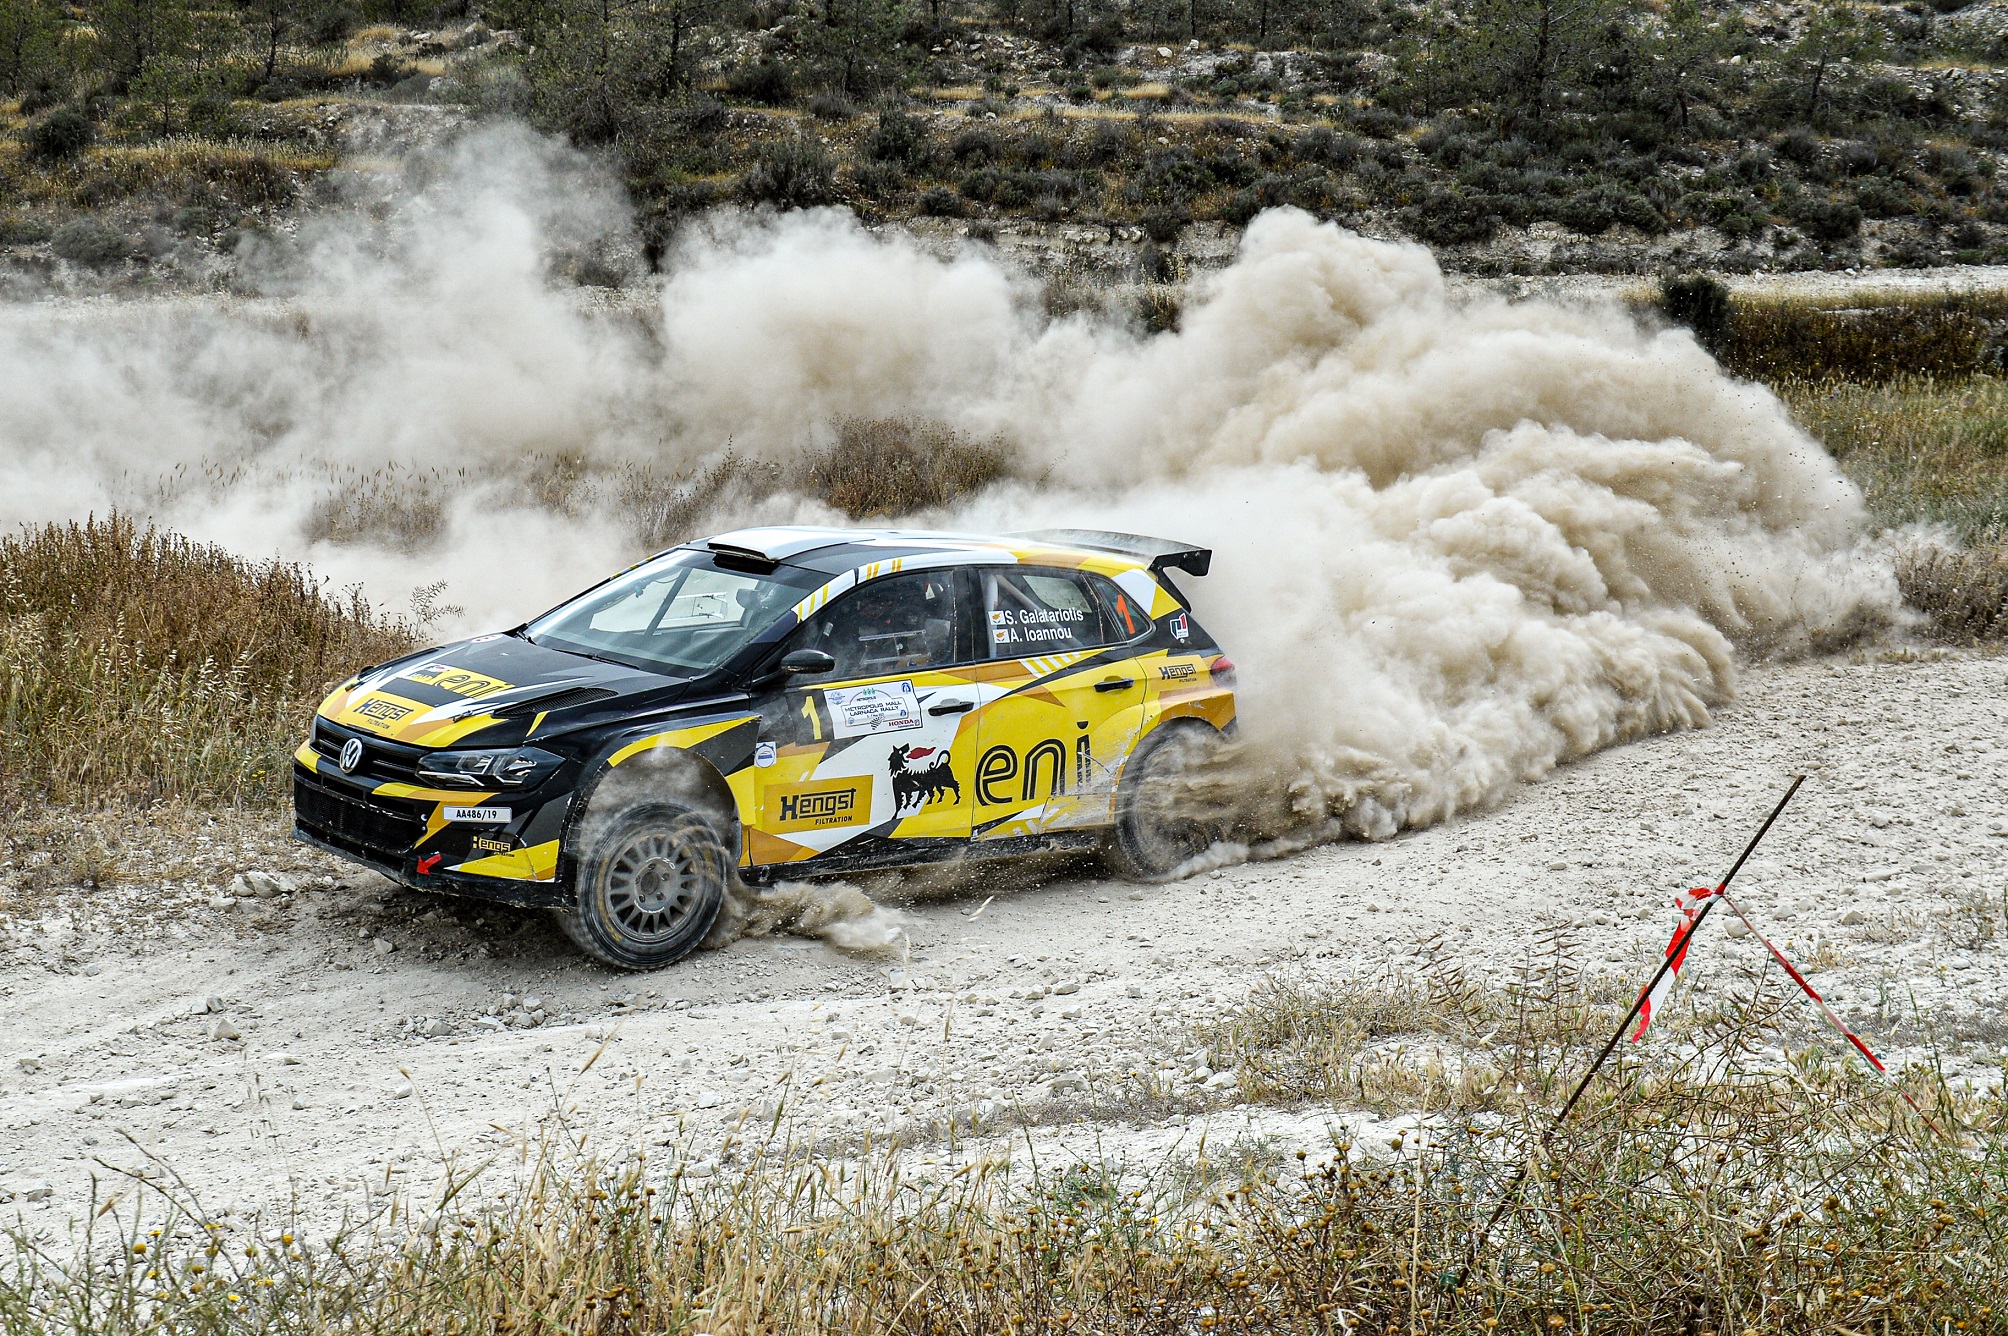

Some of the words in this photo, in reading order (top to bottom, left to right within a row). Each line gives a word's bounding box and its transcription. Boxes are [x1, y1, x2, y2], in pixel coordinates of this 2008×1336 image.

[1005, 610, 1018, 625] S.
[1116, 593, 1136, 635] 1
[1011, 628, 1023, 643] A.
[1158, 663, 1197, 680] Hengst
[434, 674, 511, 699] eni
[353, 697, 414, 721] Hengst
[845, 702, 884, 712] METROPOLIS
[849, 709, 879, 717] LARNACA
[801, 696, 822, 740] 1
[888, 719, 915, 727] HONDA
[975, 720, 1092, 806] eni
[779, 787, 856, 821] Hengst
[456, 809, 497, 821] AA486/19
[815, 815, 853, 825] FILTRATION
